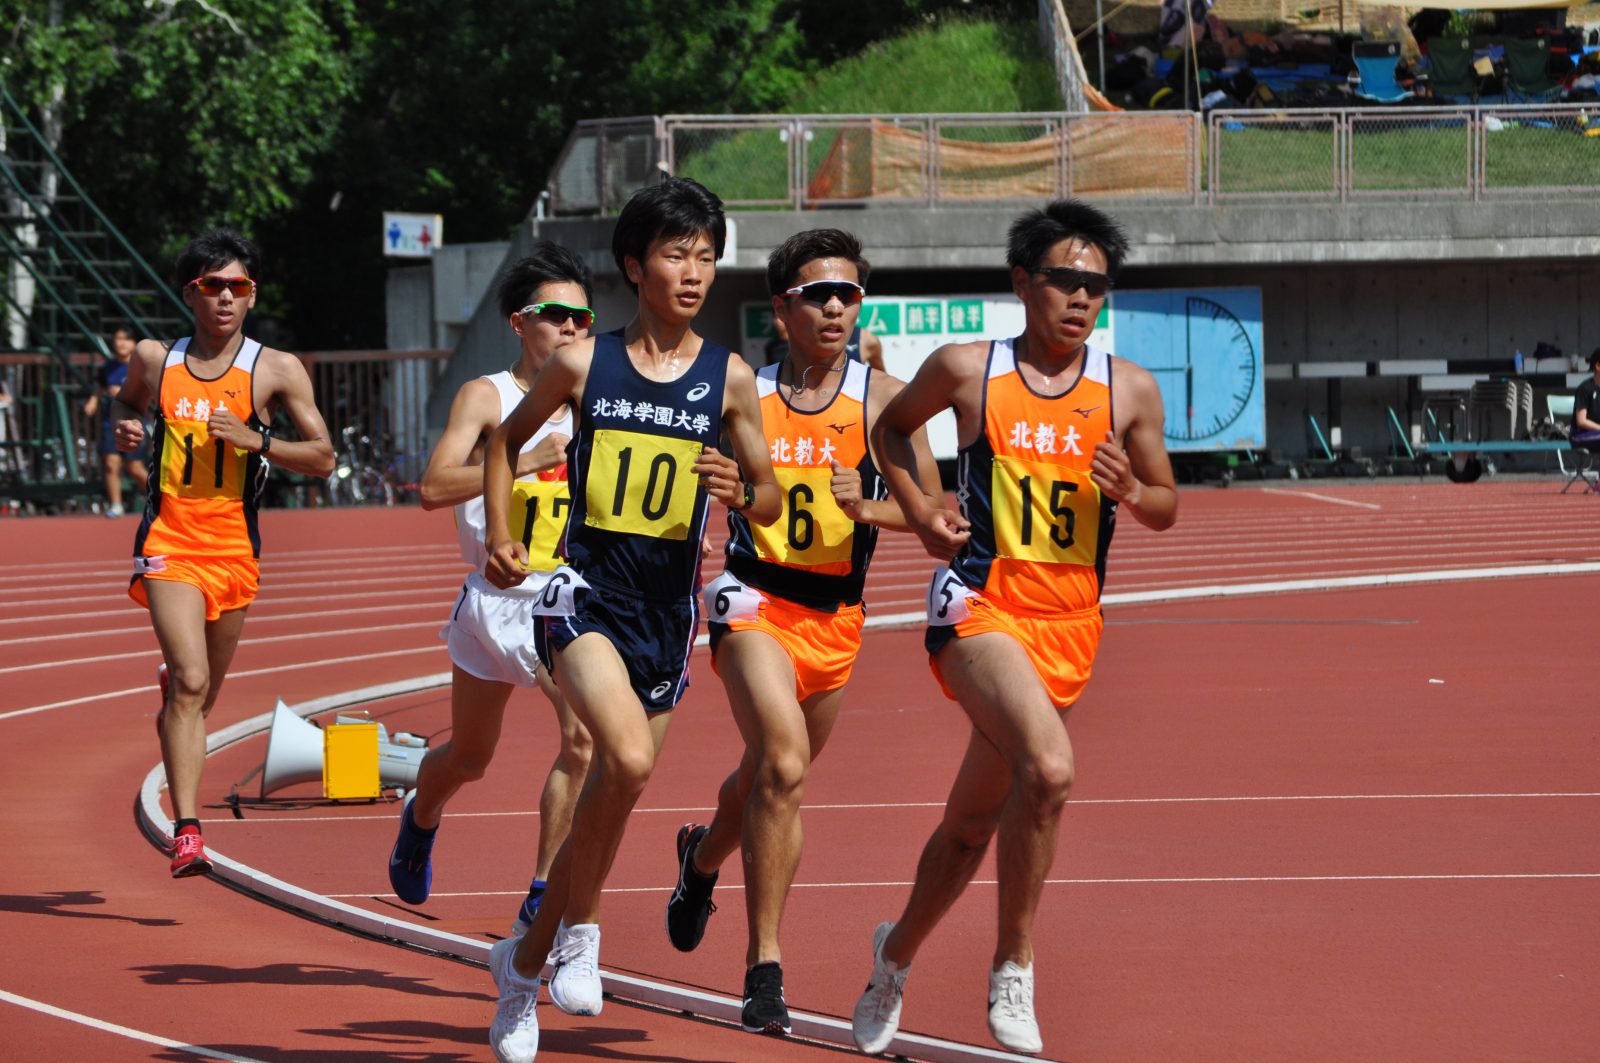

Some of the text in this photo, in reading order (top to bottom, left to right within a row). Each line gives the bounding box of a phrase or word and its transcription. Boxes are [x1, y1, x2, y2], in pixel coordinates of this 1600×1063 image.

[951, 304, 981, 330] 後半
[592, 397, 711, 435] 北海学園大学
[770, 437, 837, 466] 北教大
[1009, 421, 1083, 455] 北教大
[183, 433, 225, 488] 11
[612, 446, 677, 521] 10
[788, 483, 814, 551] 6
[1019, 475, 1079, 549] 15
[715, 586, 741, 616] 6
